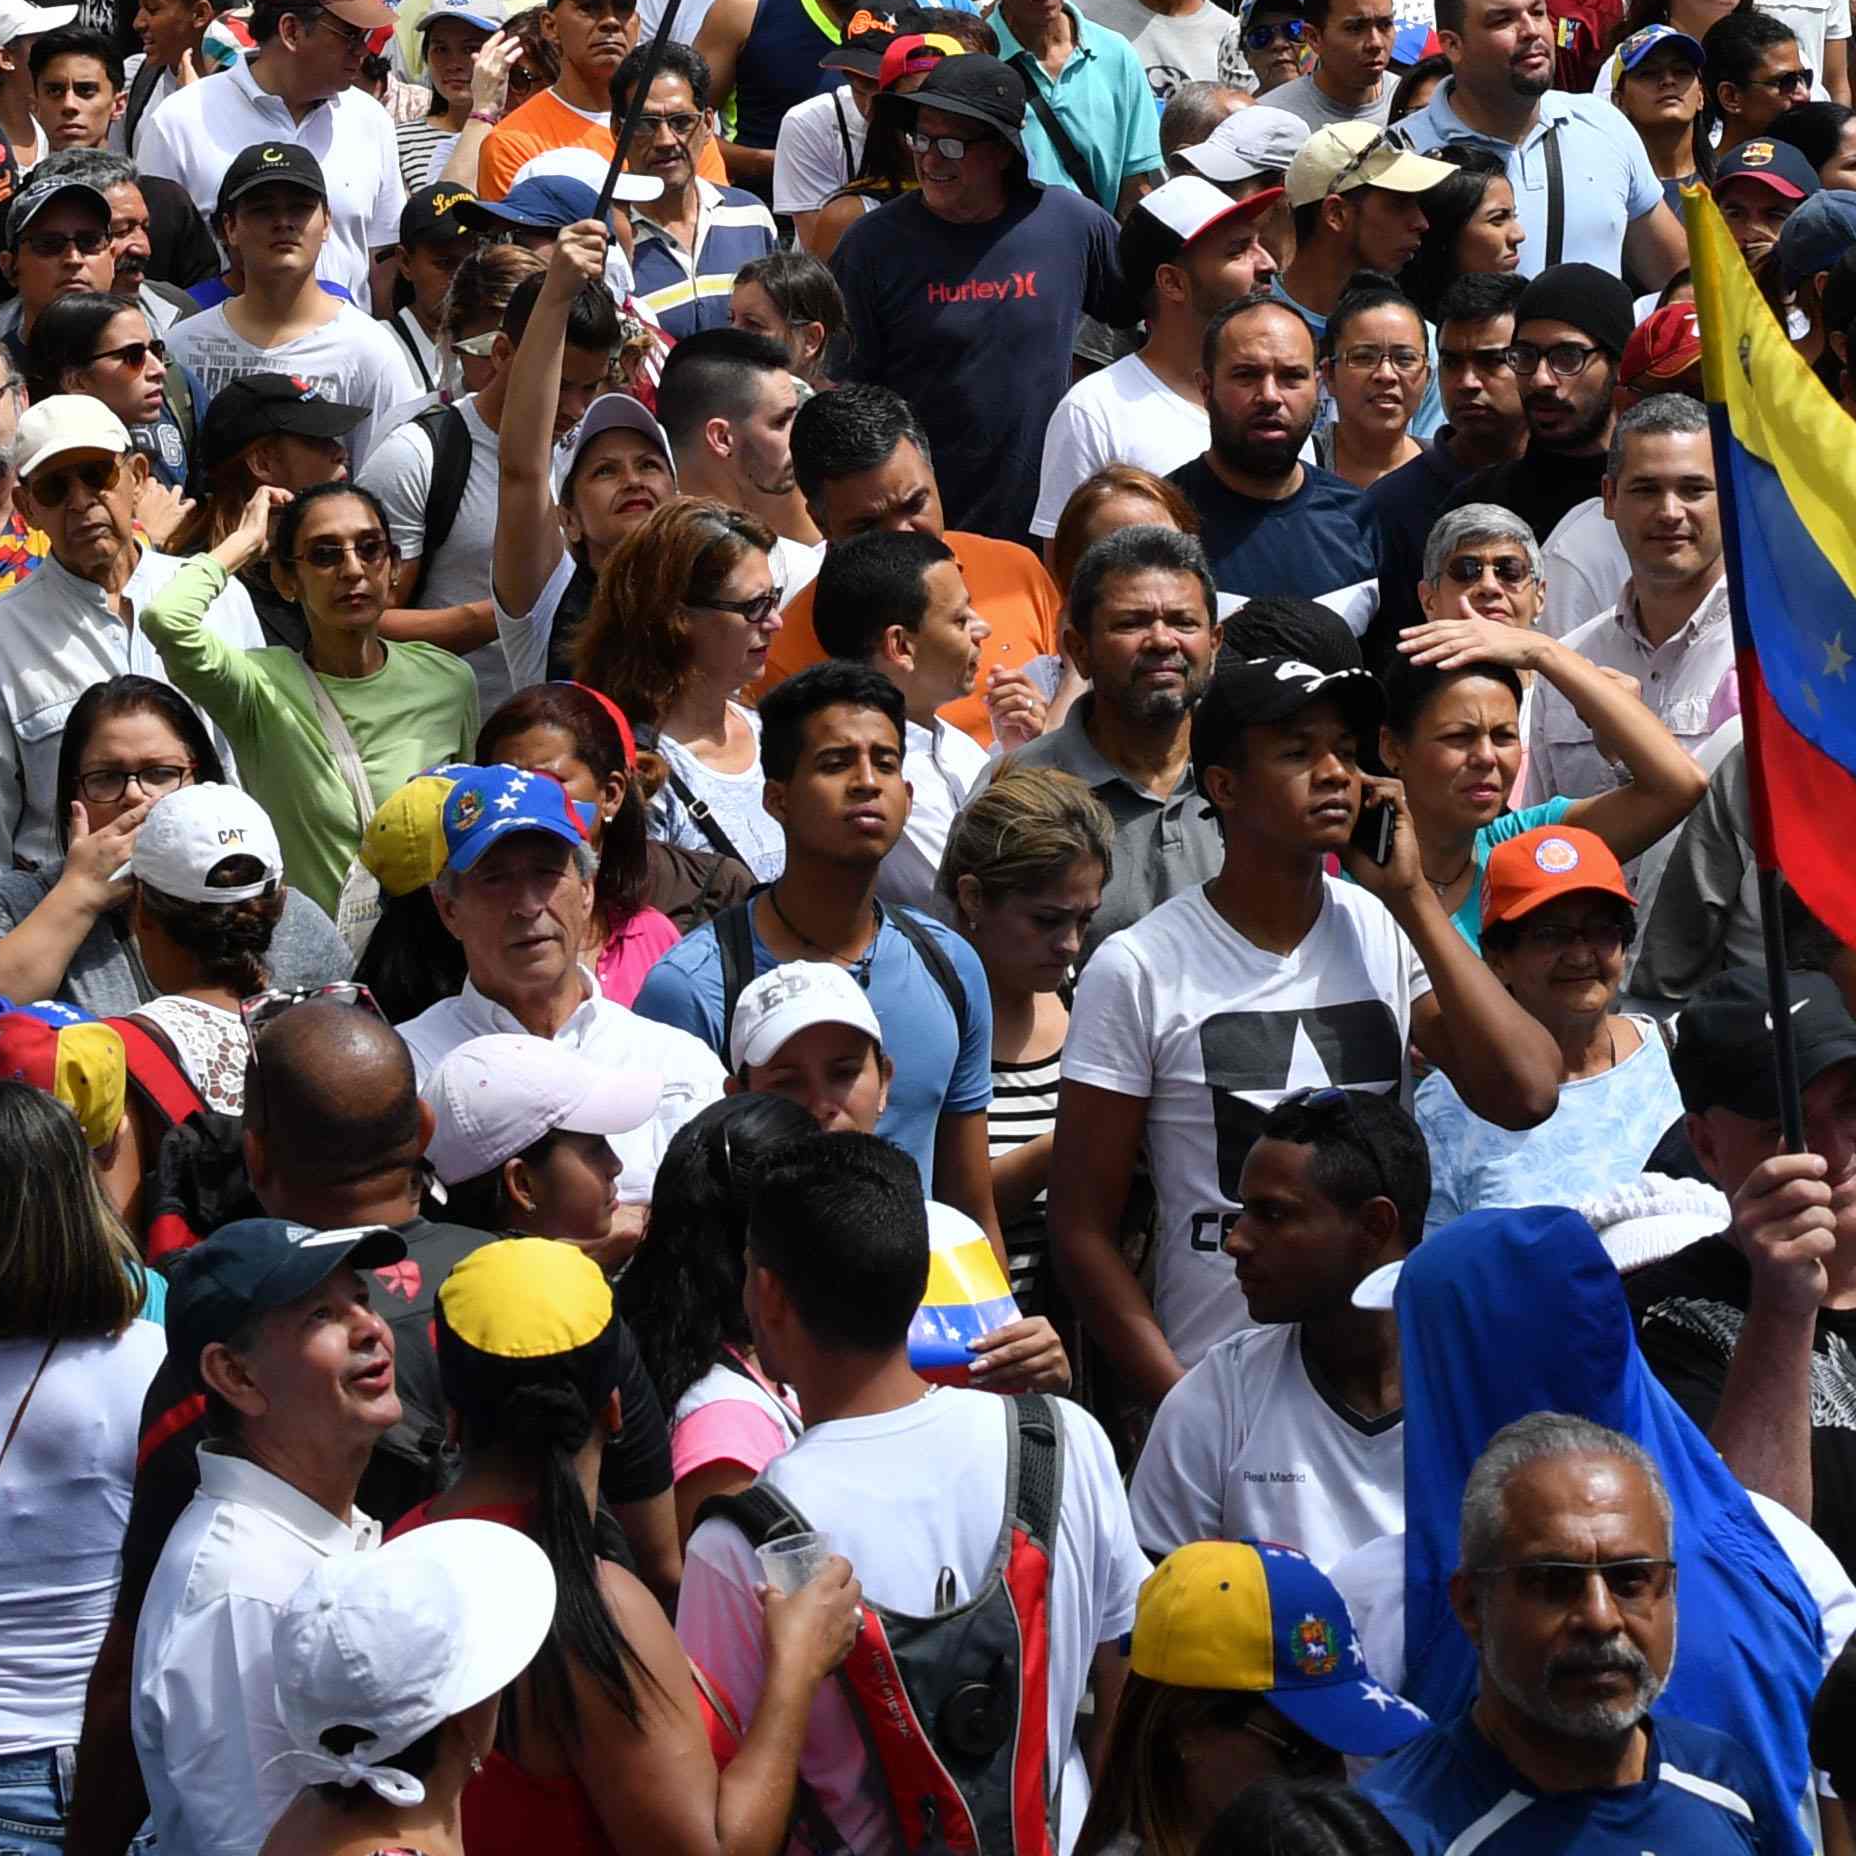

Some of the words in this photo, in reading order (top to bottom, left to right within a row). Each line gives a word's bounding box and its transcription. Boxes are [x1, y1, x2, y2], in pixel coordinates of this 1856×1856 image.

[927, 275, 1010, 305] Hurley
[218, 828, 247, 845] CAT
[1243, 1471, 1268, 1483] Real
[1272, 1470, 1308, 1483] Madrid
[870, 1647, 892, 1686] HIGH
[883, 1687, 917, 1742] SIERRA
